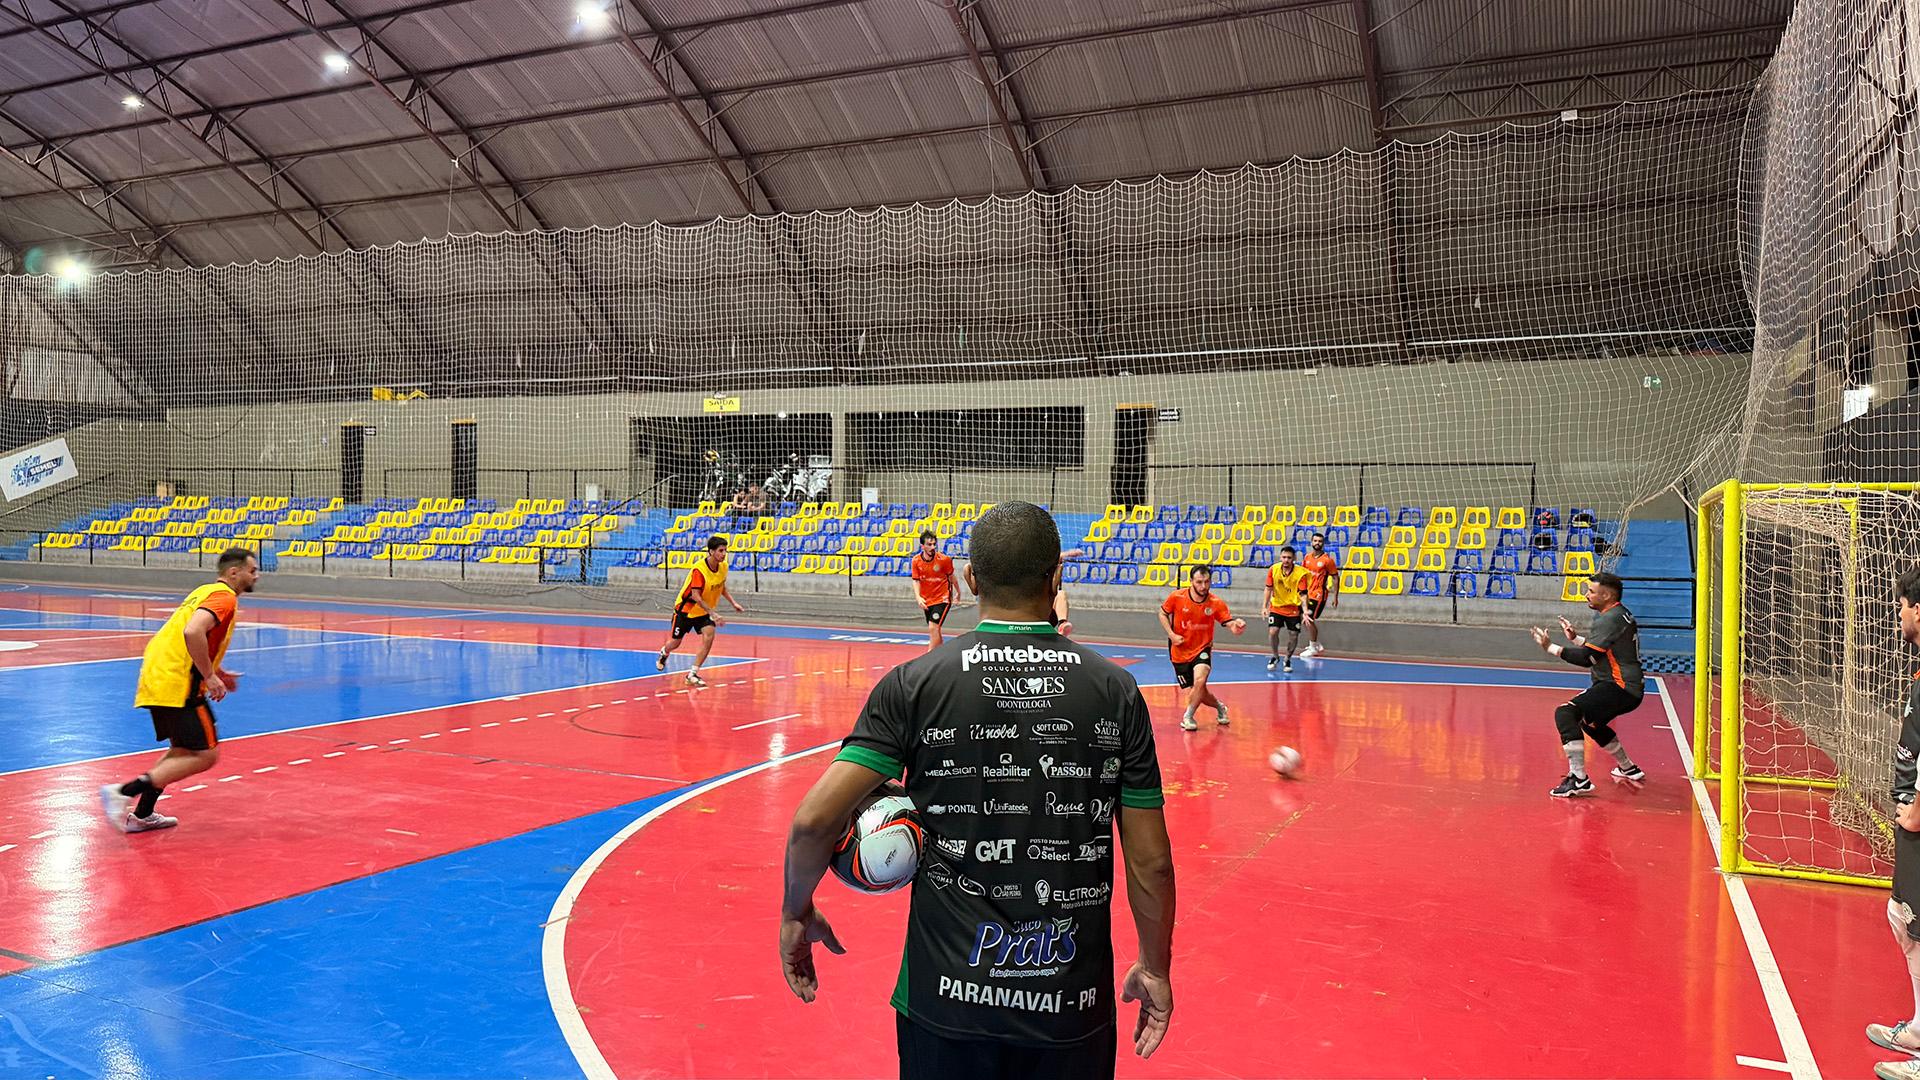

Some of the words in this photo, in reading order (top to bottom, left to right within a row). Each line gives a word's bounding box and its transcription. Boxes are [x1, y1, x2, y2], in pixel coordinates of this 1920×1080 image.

[674, 626, 680, 636] 5
[961, 641, 1082, 672] pintebem
[982, 665, 1021, 673] SOLUÇÃO
[996, 700, 1052, 709] ODONTOLOGIA
[985, 723, 1020, 740] nobel
[1036, 723, 1051, 731] SOFT
[1052, 723, 1068, 732] CARD
[926, 727, 957, 742] Fiber
[982, 765, 1031, 778] Reabilitar
[1050, 766, 1092, 777] PASSOLI
[948, 804, 978, 814] PONTAL
[975, 839, 1016, 862] GVT
[1041, 850, 1071, 861] Select
[938, 975, 1063, 1013] PARANAVAÍ
[1079, 987, 1097, 1011] PR
